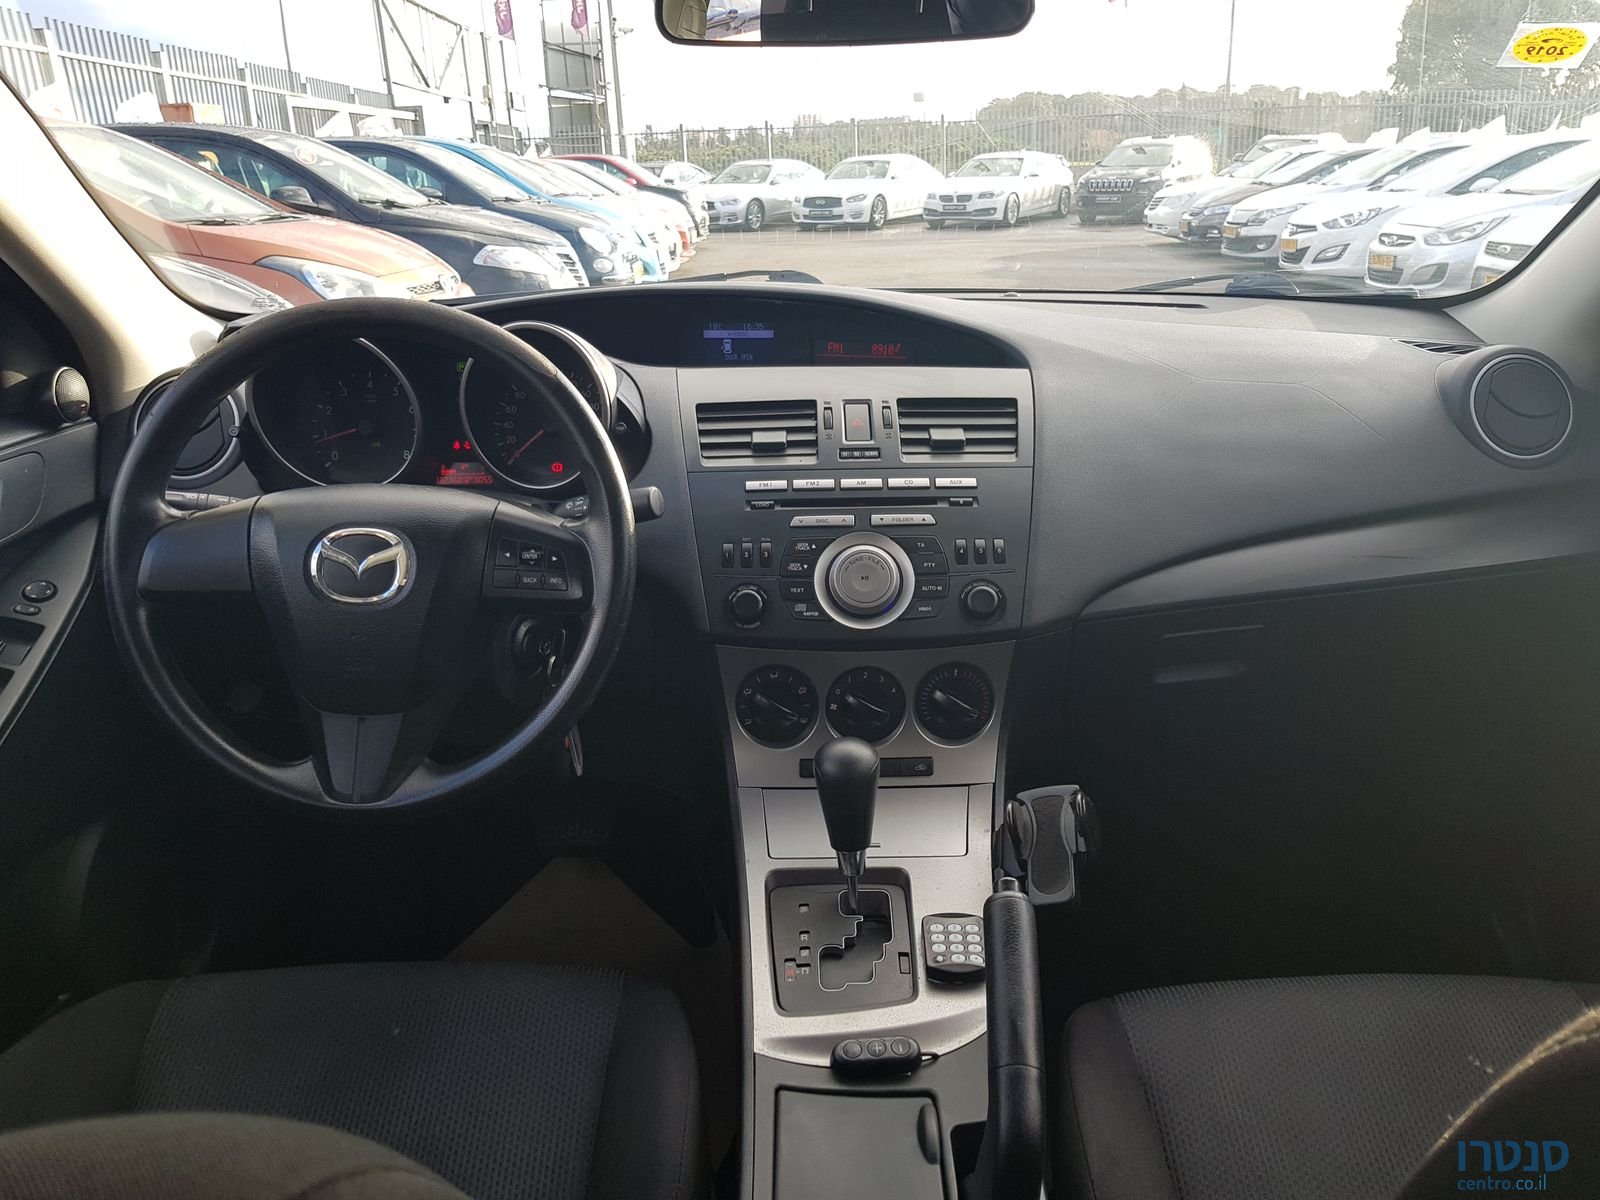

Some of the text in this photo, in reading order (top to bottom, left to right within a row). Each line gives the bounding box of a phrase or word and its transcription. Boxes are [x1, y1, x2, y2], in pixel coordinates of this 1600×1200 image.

[827, 342, 843, 353] FM1
[342, 387, 348, 397] 3
[393, 386, 399, 396] 5
[325, 406, 332, 415] 2
[331, 451, 339, 461] 0
[403, 450, 410, 460] 8
[863, 671, 868, 679] 2
[801, 933, 809, 942] R
